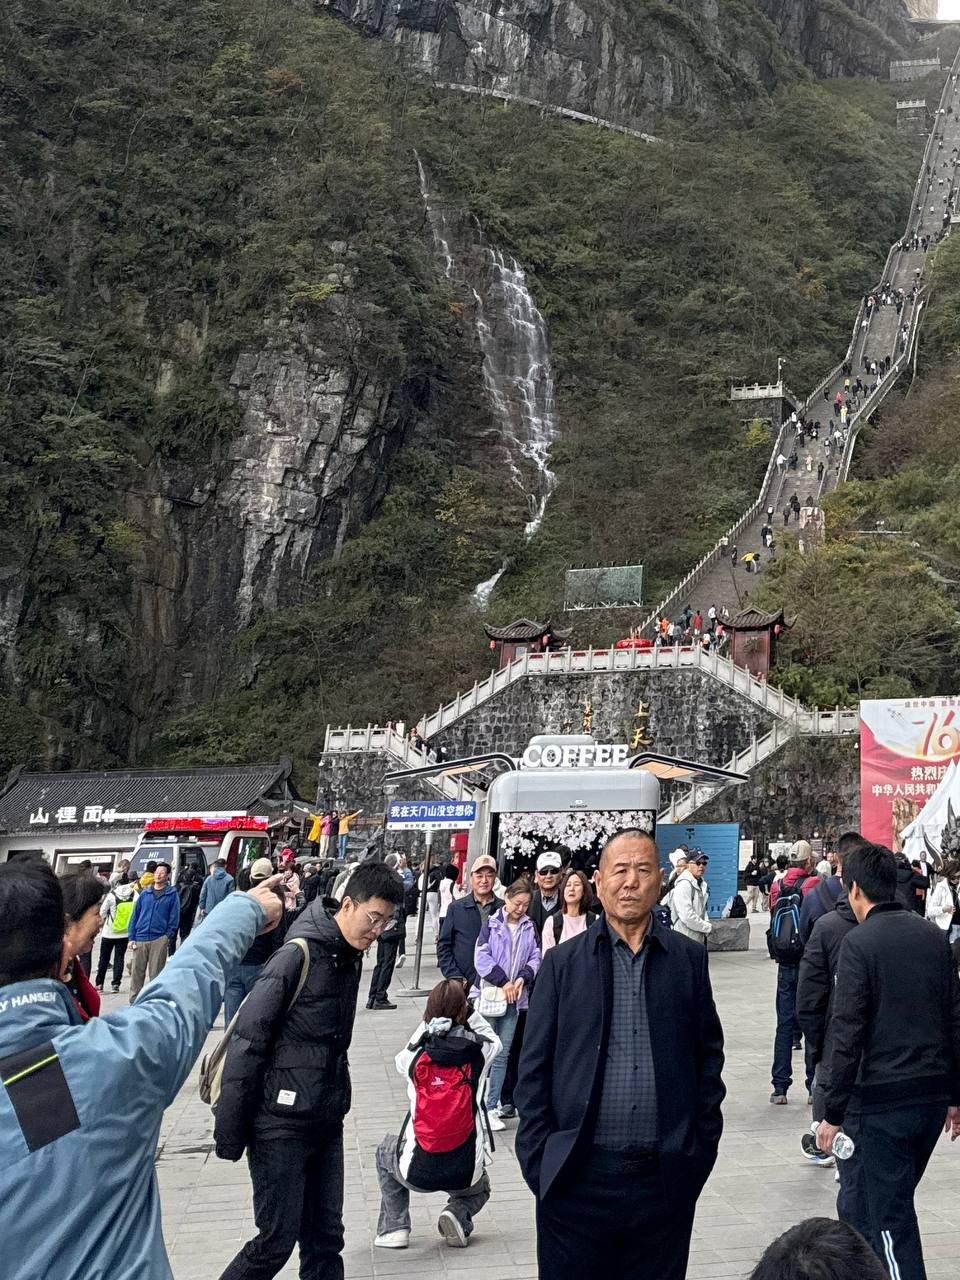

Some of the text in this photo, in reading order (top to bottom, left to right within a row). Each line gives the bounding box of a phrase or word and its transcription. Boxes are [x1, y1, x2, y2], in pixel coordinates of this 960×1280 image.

[523, 744, 629, 768] COFFEE
[911, 765, 948, 781] 热烈庆
[872, 783, 941, 797] 中华人民共和
[390, 804, 474, 817] 我在天门山没空想你
[11, 991, 57, 1008] HANSEN
